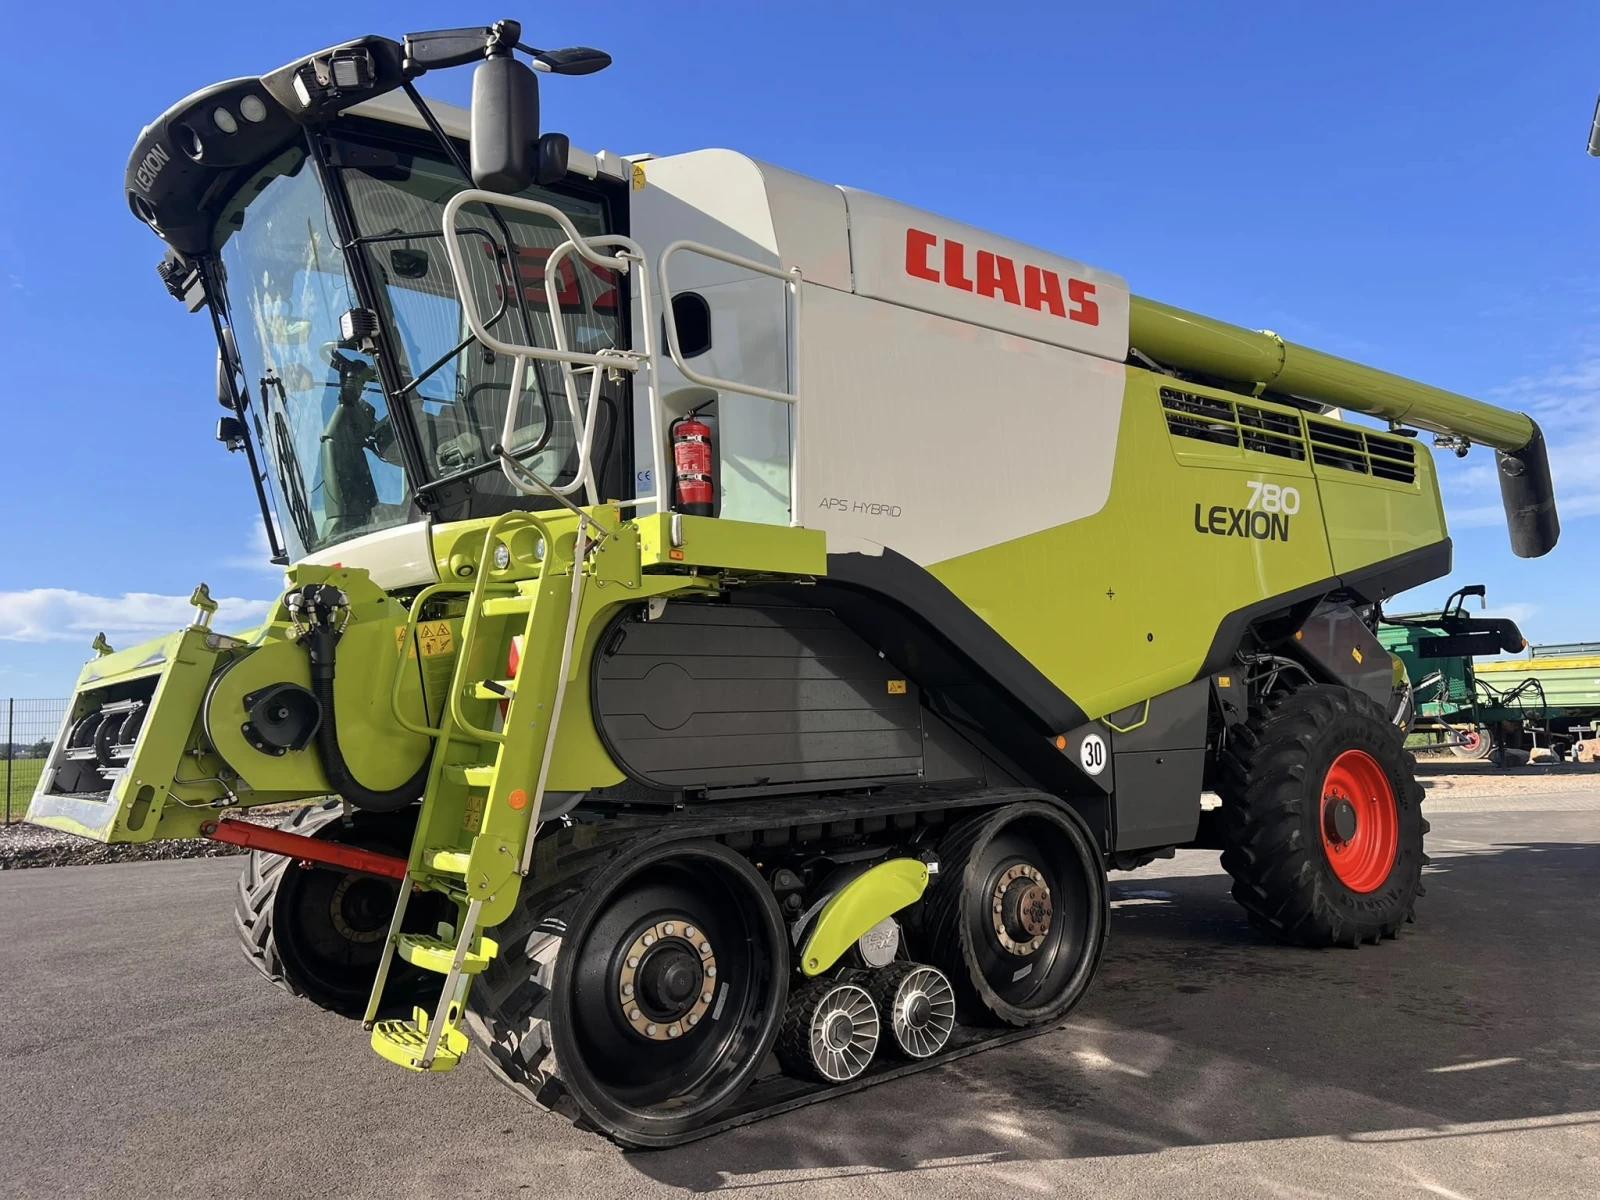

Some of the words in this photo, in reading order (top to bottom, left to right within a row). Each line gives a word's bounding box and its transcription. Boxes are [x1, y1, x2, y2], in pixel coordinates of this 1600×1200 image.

[134, 143, 170, 193] LEXION
[905, 228, 1100, 327] CLAAS
[637, 470, 651, 481] CE
[818, 497, 848, 511] APS
[853, 501, 902, 517] HYBRID
[1246, 480, 1300, 515] 780
[1194, 503, 1289, 542] LEXION
[1085, 741, 1102, 767] 30
[863, 930, 896, 944] TERRA
[870, 939, 894, 951] TRAC
